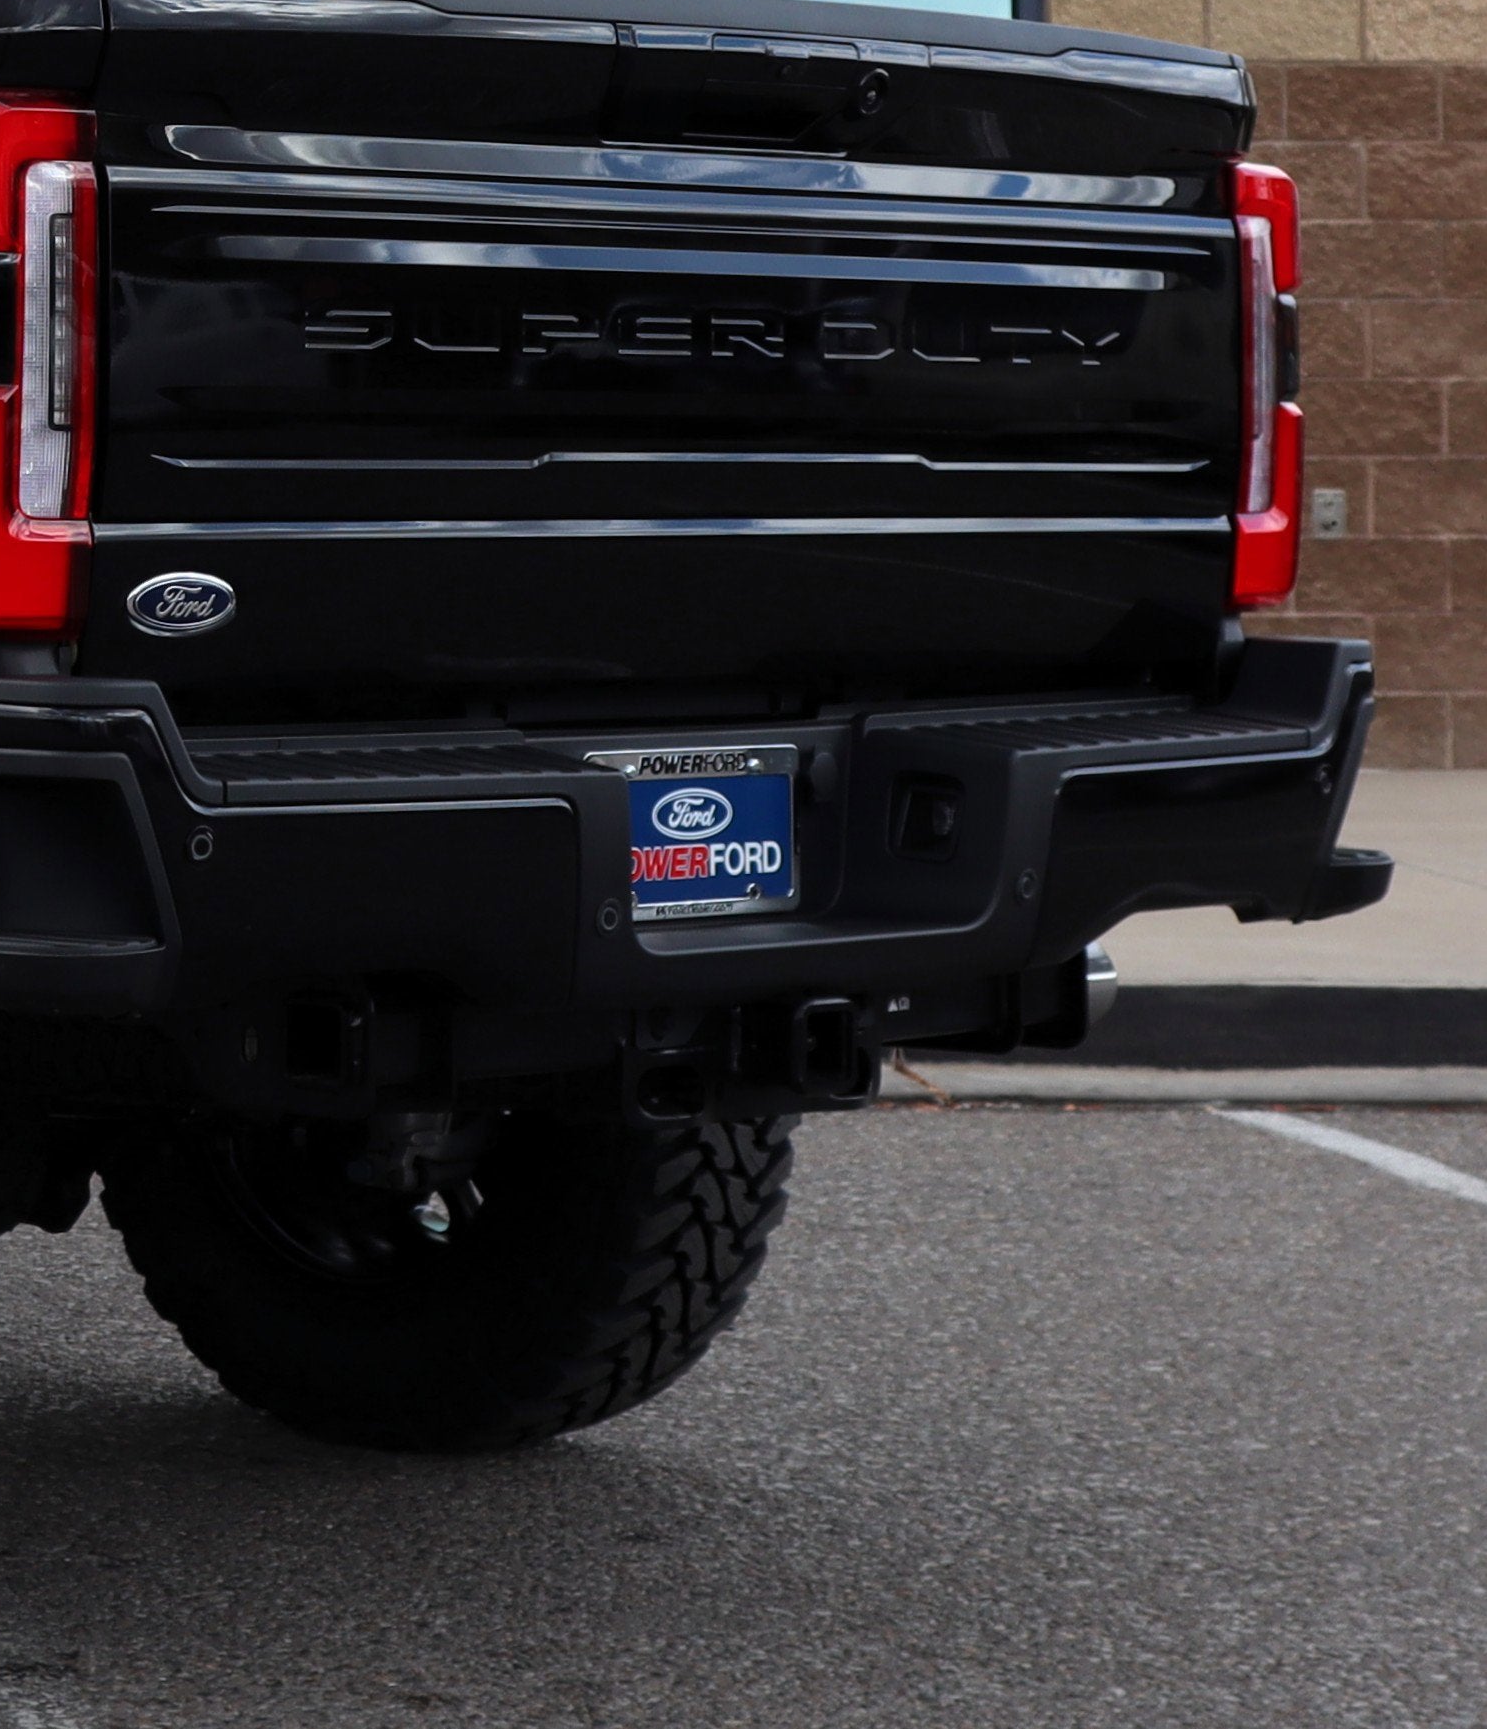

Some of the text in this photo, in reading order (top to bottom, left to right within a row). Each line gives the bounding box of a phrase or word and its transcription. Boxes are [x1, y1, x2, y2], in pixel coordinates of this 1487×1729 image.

[304, 308, 1121, 367] SUPER DUTY
[155, 585, 217, 618] Ford
[639, 753, 748, 776] POWERFORD
[668, 797, 716, 828] Ford
[630, 841, 782, 882] OWERFORD
